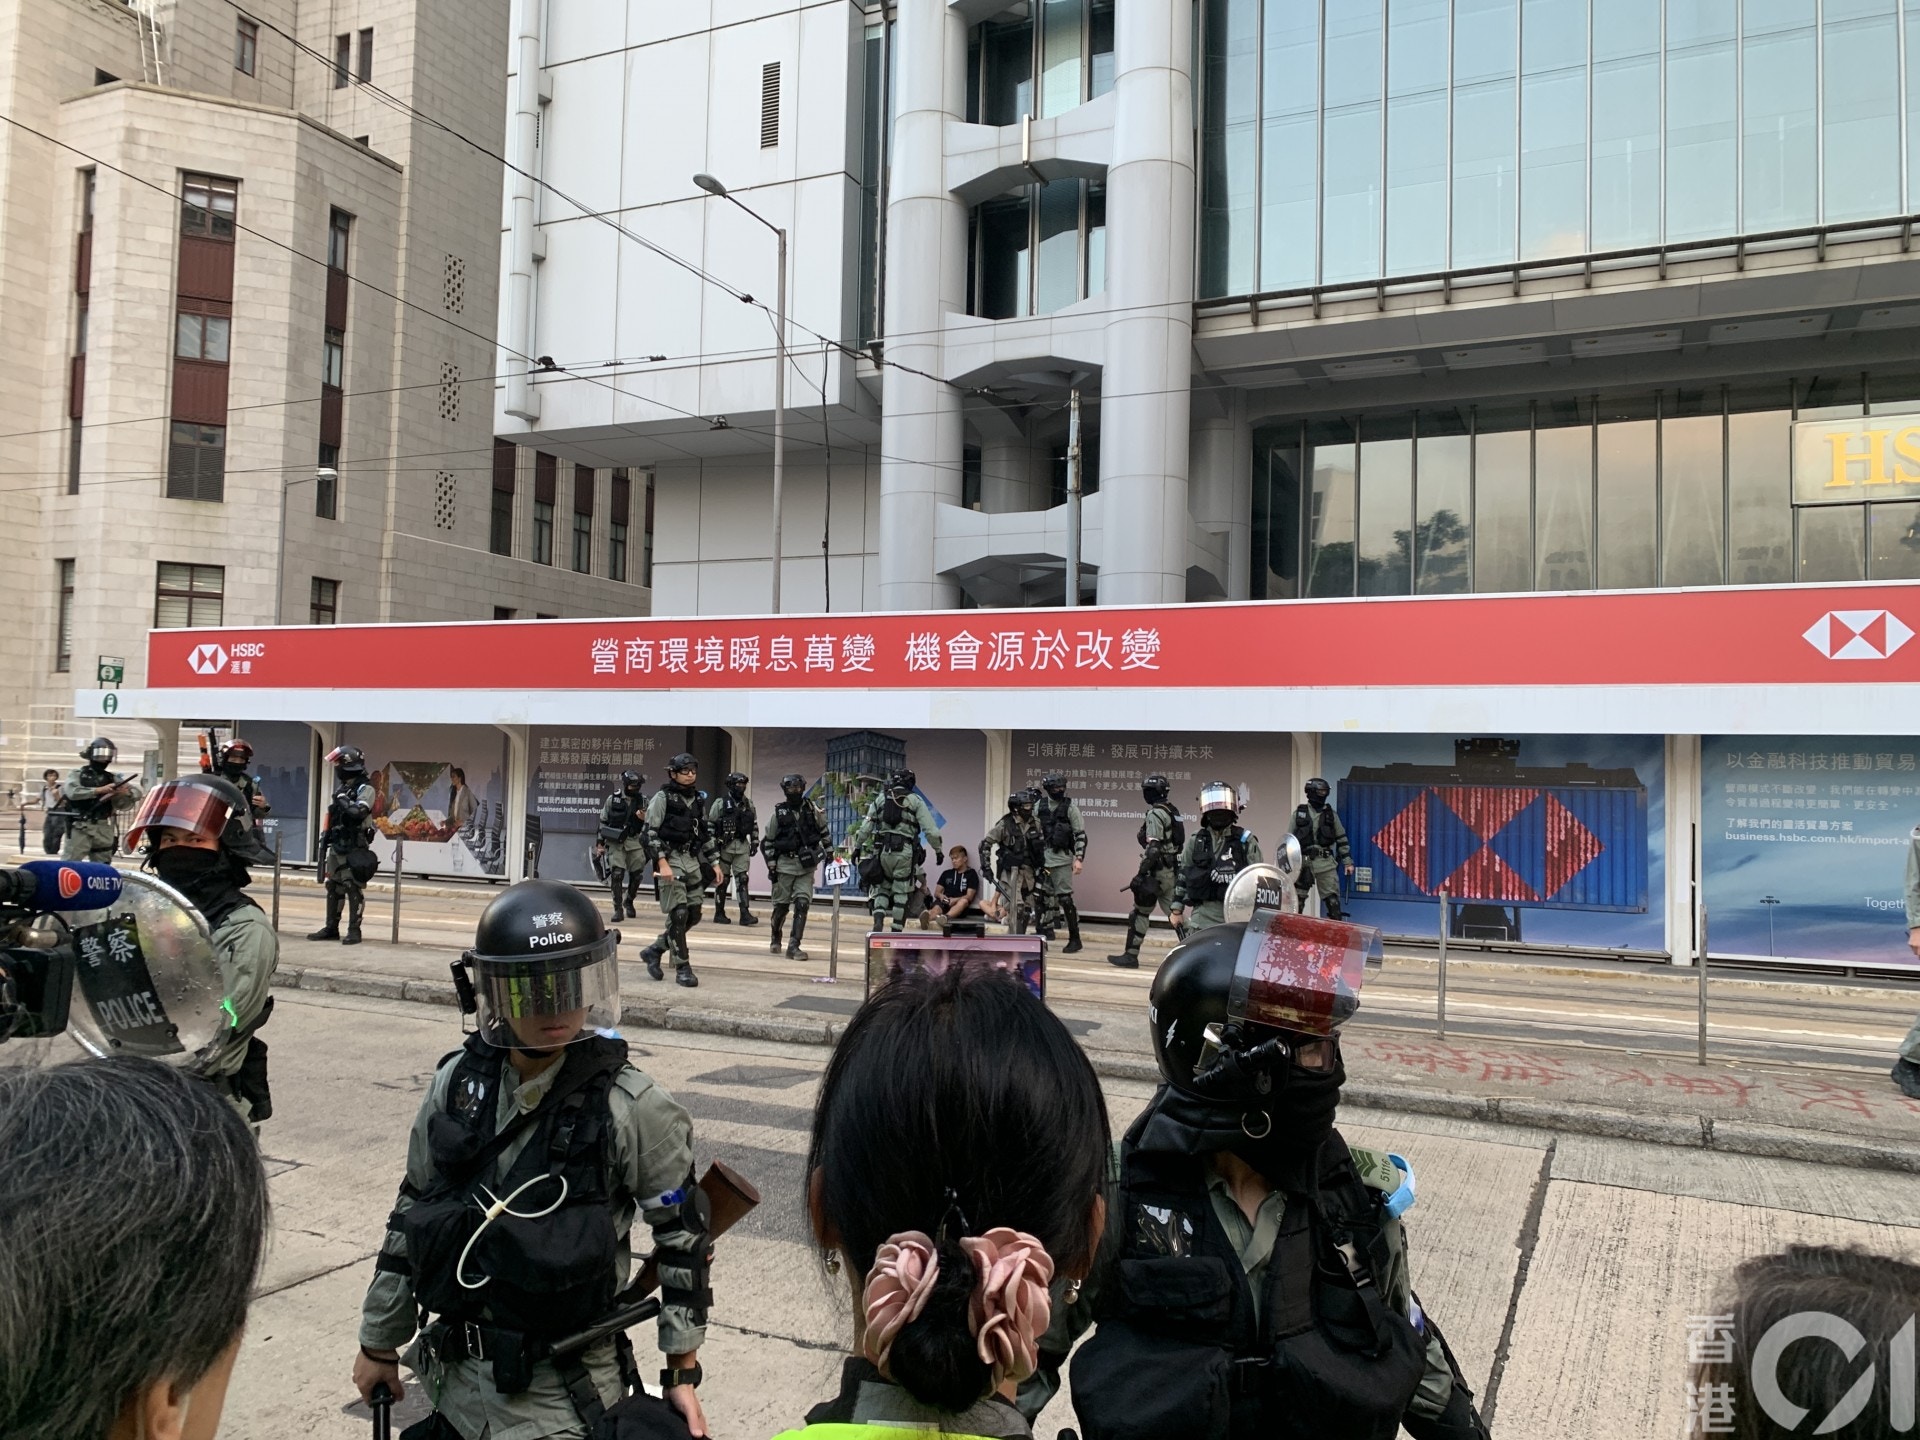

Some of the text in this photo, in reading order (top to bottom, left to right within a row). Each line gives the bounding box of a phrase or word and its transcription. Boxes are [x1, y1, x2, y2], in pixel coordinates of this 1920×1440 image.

[230, 643, 265, 657] HSBC
[591, 627, 1161, 674] 營商環境瞬息萬變 機會源於改變
[1027, 743, 1214, 760] 引領新思維，發展可持續未來
[828, 865, 848, 881] HK
[87, 876, 122, 890] CABLE TV
[1256, 887, 1280, 905] POLICE
[532, 912, 564, 928] 警察
[80, 928, 136, 967] 警察
[529, 932, 573, 948] Police
[97, 991, 164, 1032] POLICE
[1380, 1158, 1391, 1182] 51116
